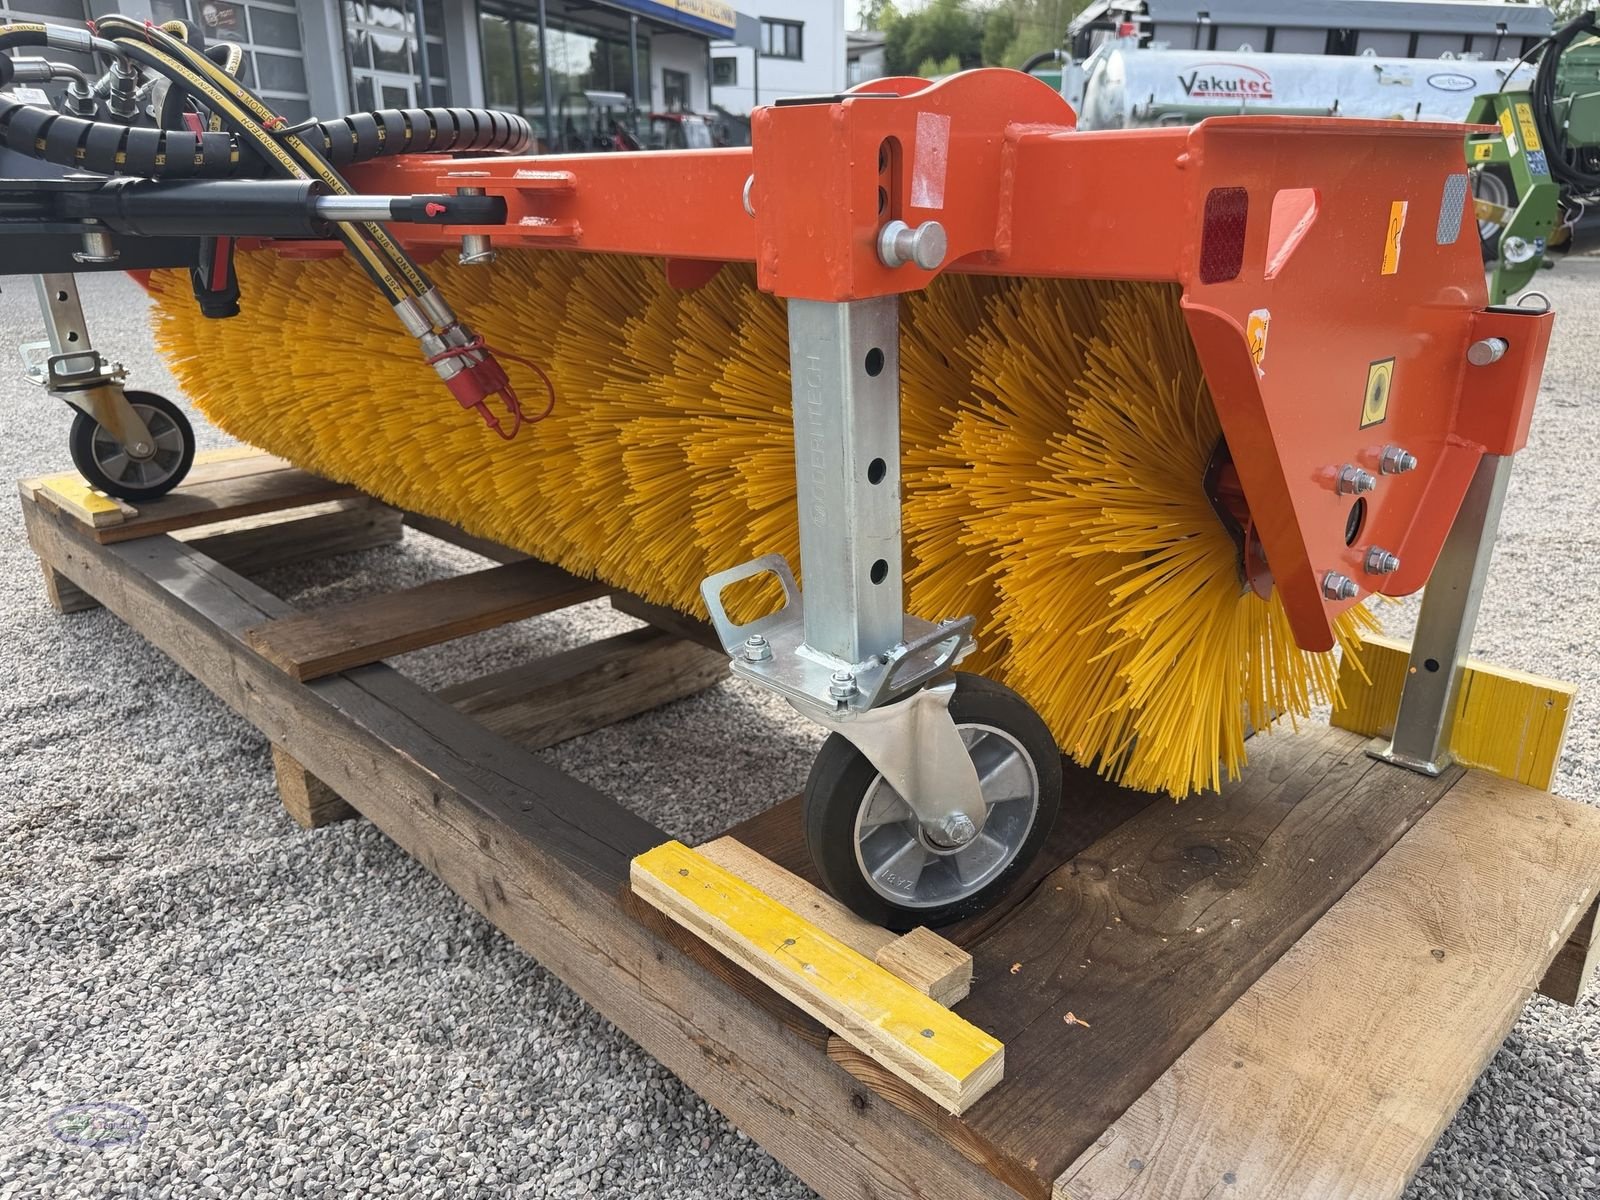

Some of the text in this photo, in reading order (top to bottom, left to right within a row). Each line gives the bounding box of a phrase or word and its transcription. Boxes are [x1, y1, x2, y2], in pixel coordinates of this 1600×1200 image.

[208, 88, 223, 101] DIN
[1177, 71, 1273, 96] Vakutec
[240, 117, 299, 172] MODERNTECH
[321, 169, 338, 187] DIN
[395, 256, 416, 280] DN10
[413, 279, 428, 295] MM
